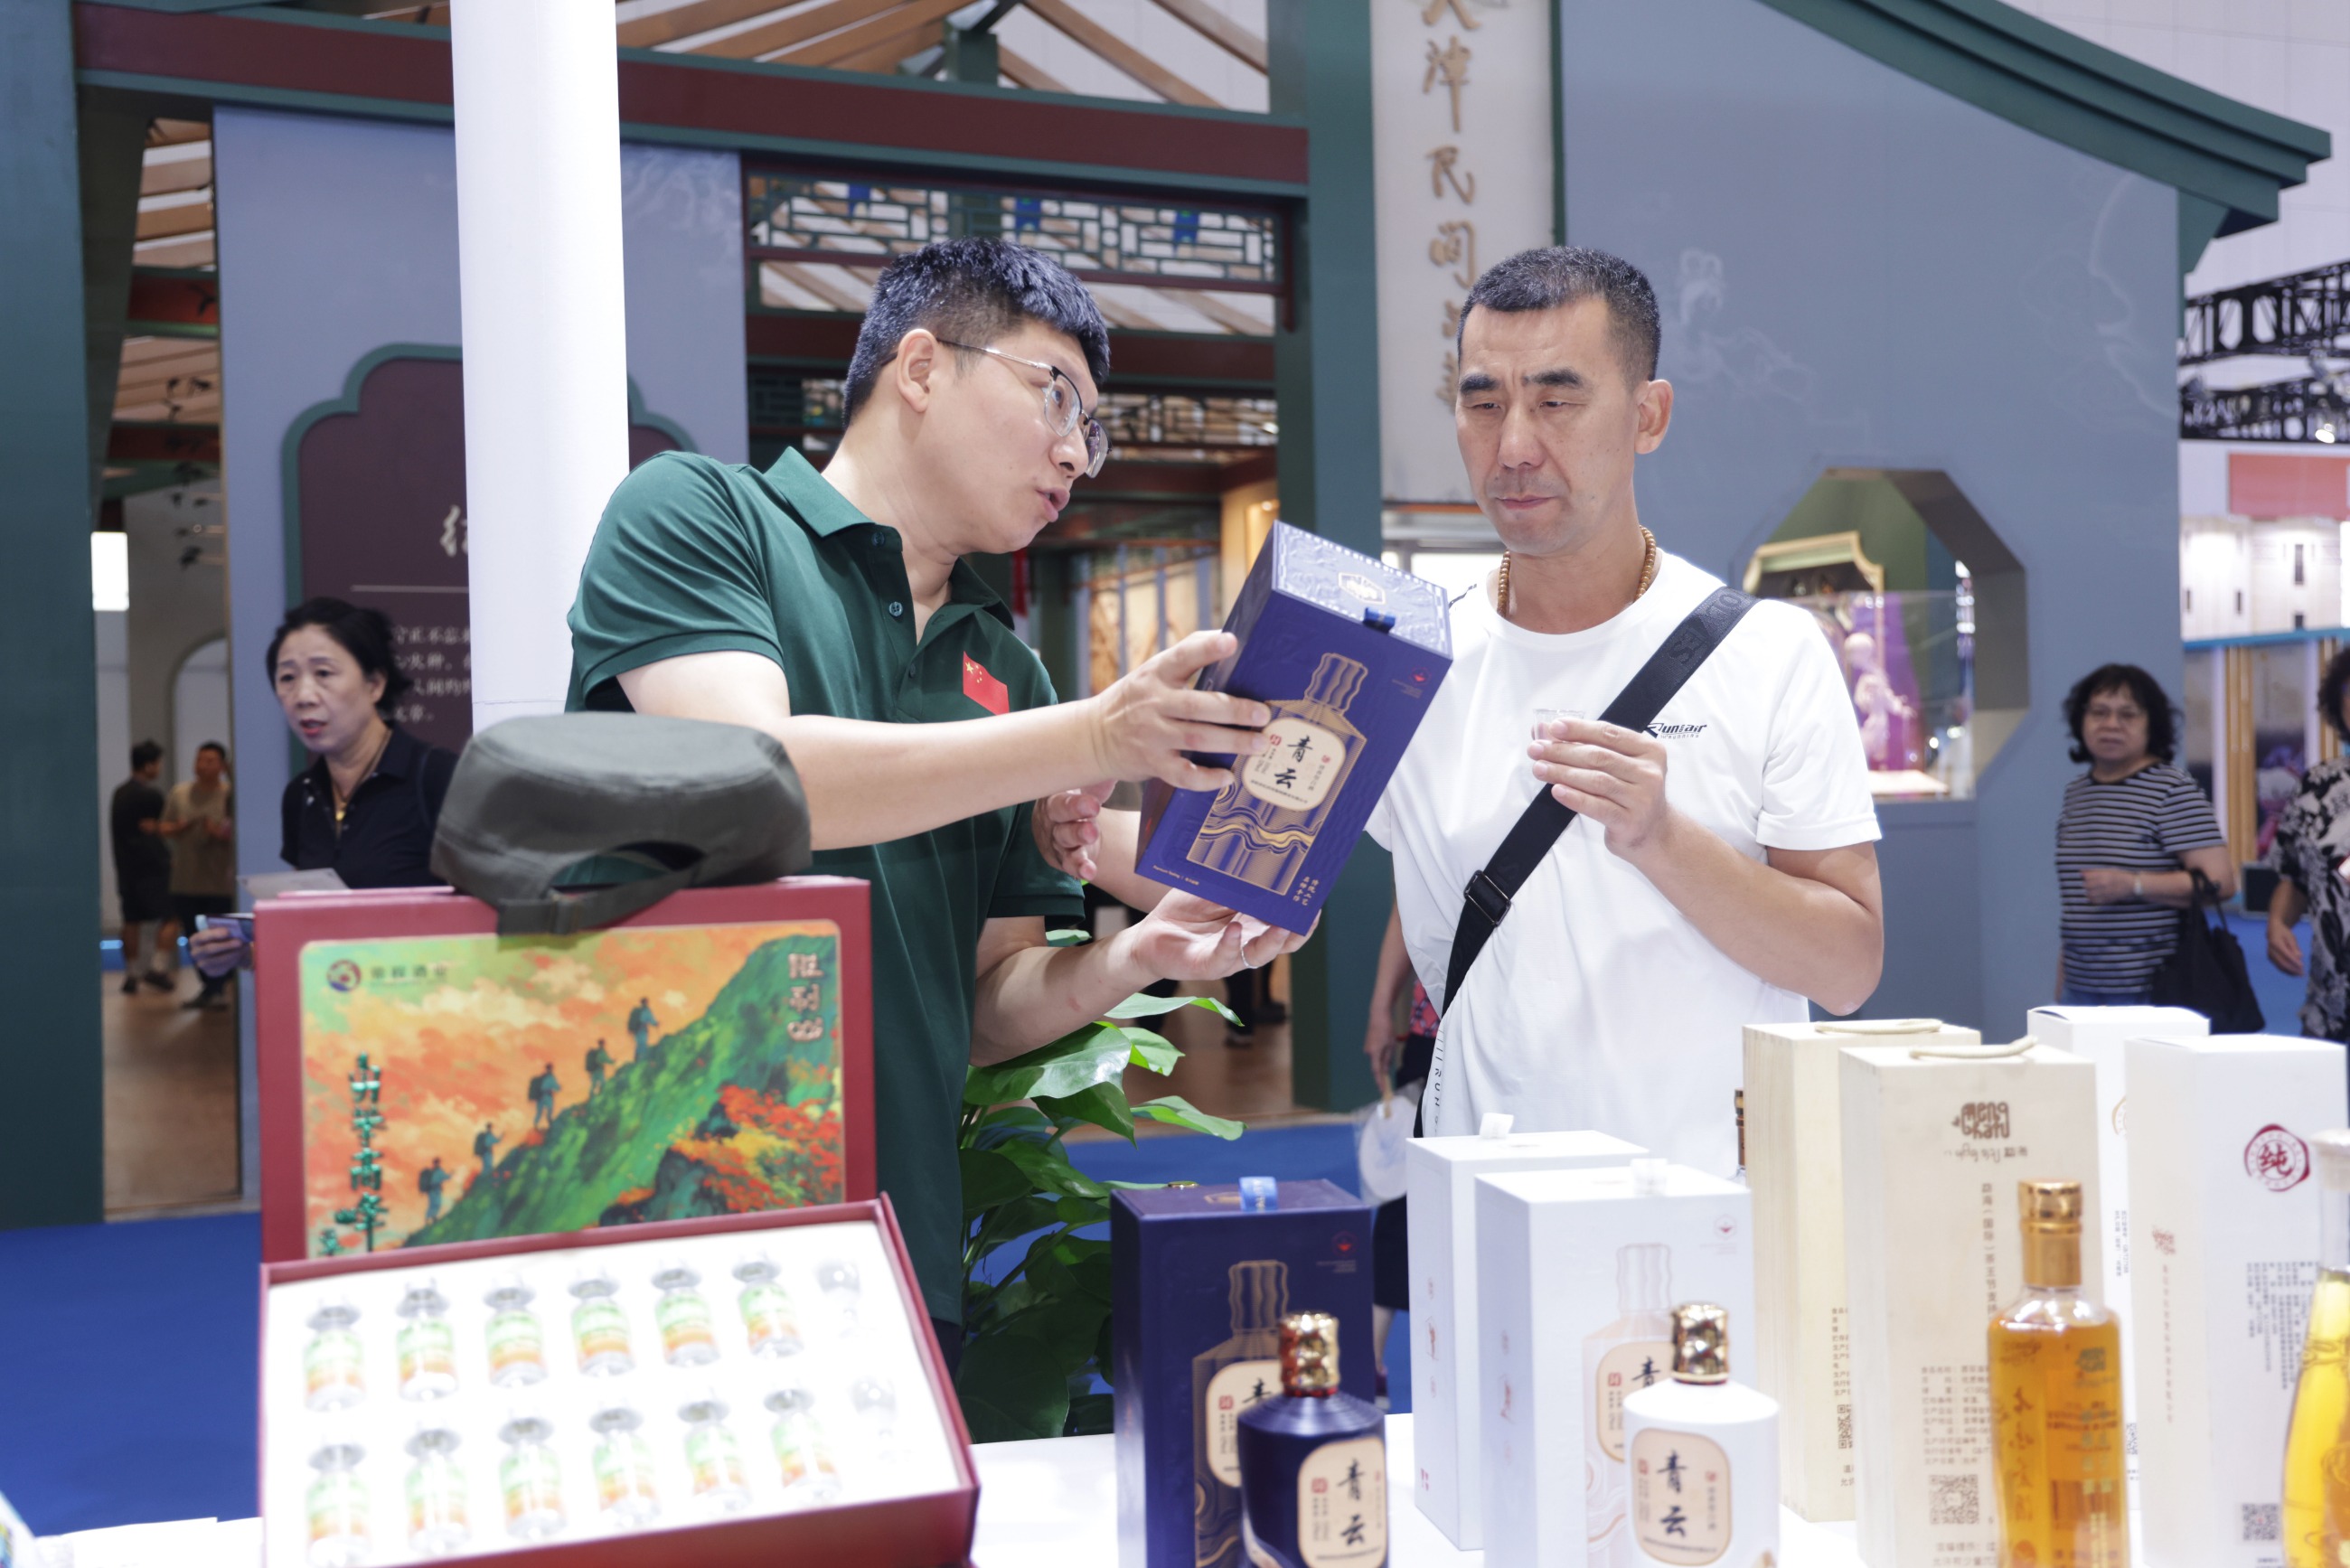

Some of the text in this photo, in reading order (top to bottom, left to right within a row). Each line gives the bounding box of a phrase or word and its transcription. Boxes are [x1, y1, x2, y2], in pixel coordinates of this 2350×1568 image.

[1275, 735, 1314, 790] 青云
[1337, 1458, 1366, 1546] 青云
[1657, 1449, 1687, 1538] 青云
